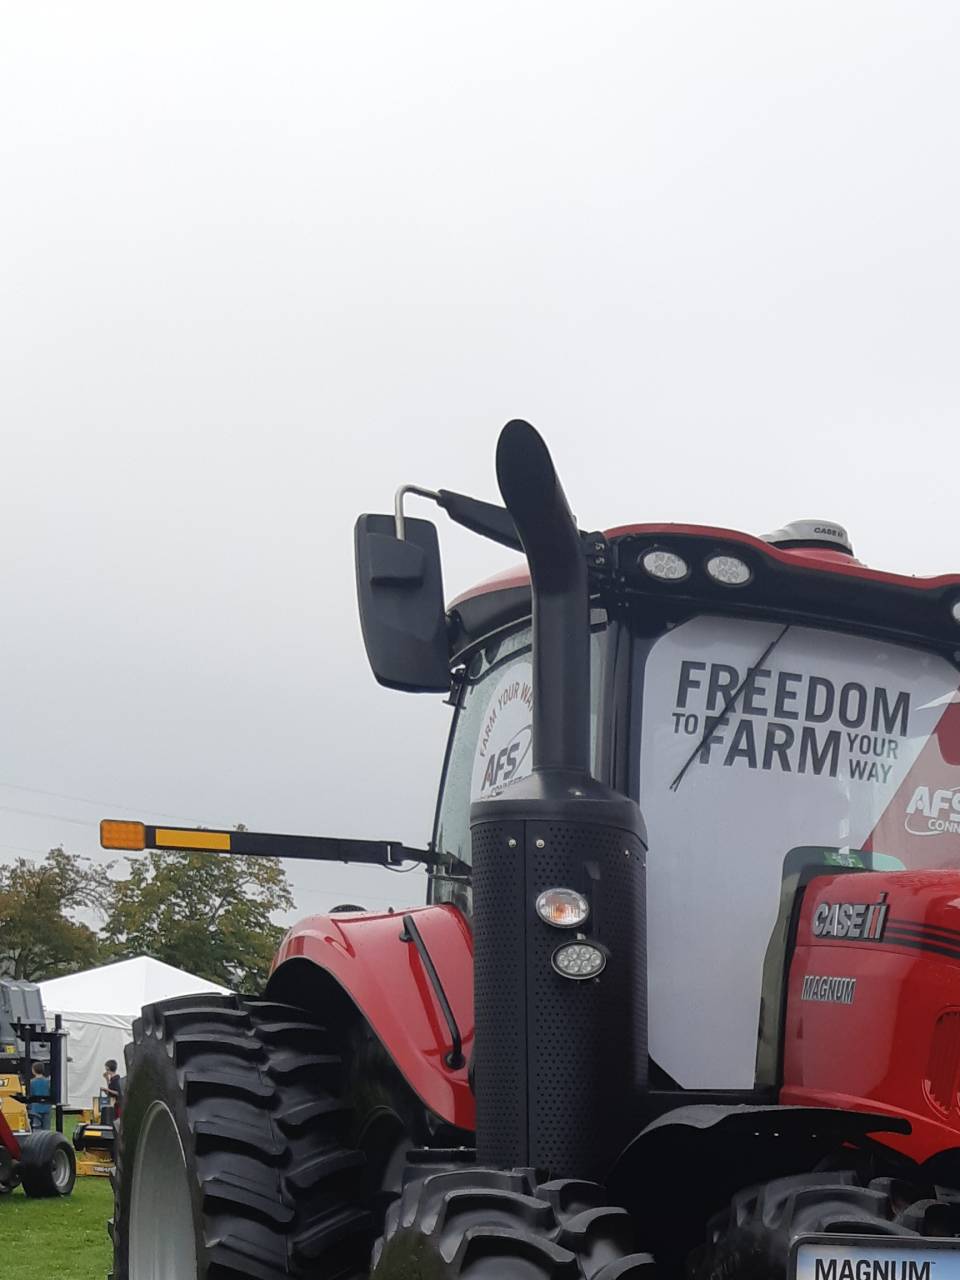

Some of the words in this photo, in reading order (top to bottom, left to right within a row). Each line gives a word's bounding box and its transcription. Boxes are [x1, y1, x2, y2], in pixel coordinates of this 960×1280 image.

[480, 708, 498, 758] FARM
[498, 681, 521, 711] YOUR
[520, 681, 534, 712] WA
[676, 660, 911, 737] FREEDOM
[481, 742, 521, 791] AFS
[672, 712, 699, 736] TO
[698, 715, 842, 778] FARM
[847, 732, 899, 760] YOUR
[849, 759, 893, 784] WAY
[813, 903, 866, 938] CASE
[801, 976, 856, 1005] MAGNUM
